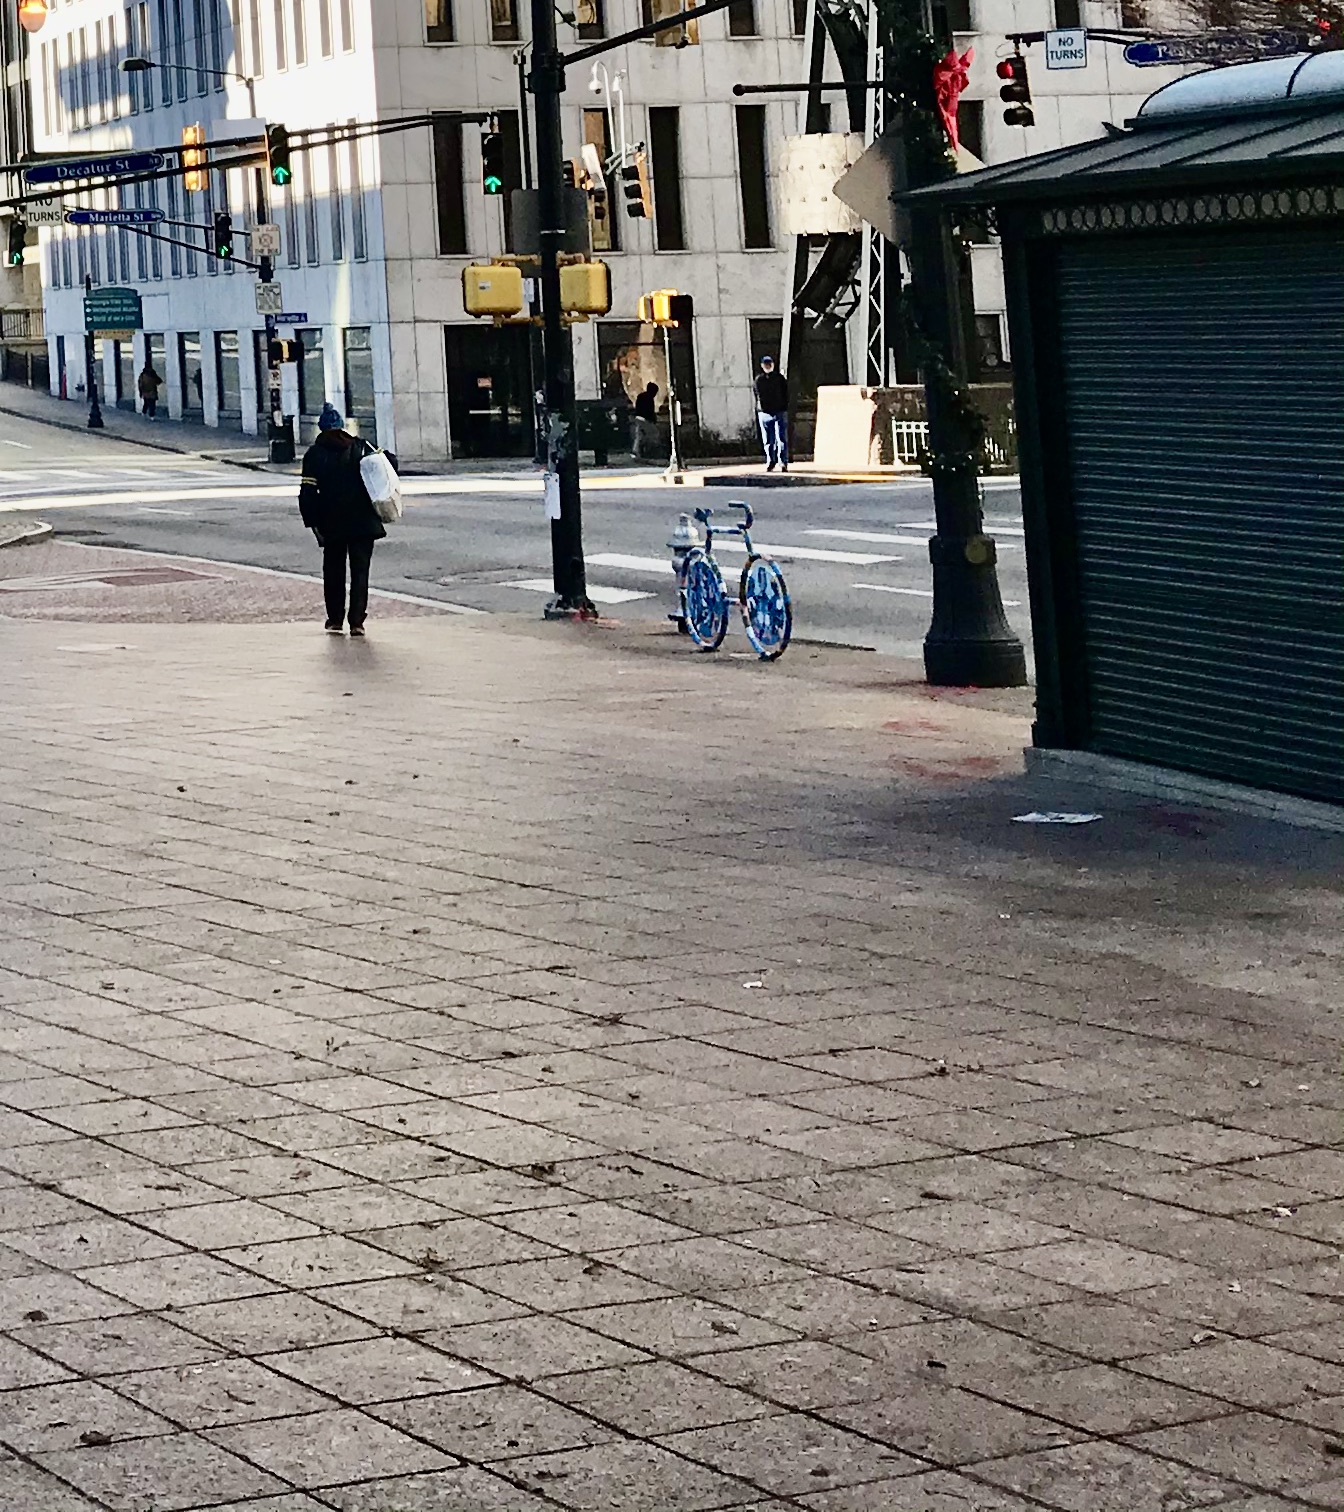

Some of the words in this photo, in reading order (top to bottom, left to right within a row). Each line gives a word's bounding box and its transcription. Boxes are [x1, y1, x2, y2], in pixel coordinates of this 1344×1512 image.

[1057, 37, 1075, 48] NO
[1049, 49, 1085, 62] TURNS
[56, 162, 112, 178] Decatur
[115, 159, 130, 171] St
[34, 197, 53, 207] NO
[27, 211, 61, 222] TURNS
[88, 211, 131, 223] Marietta
[133, 211, 144, 222] St
